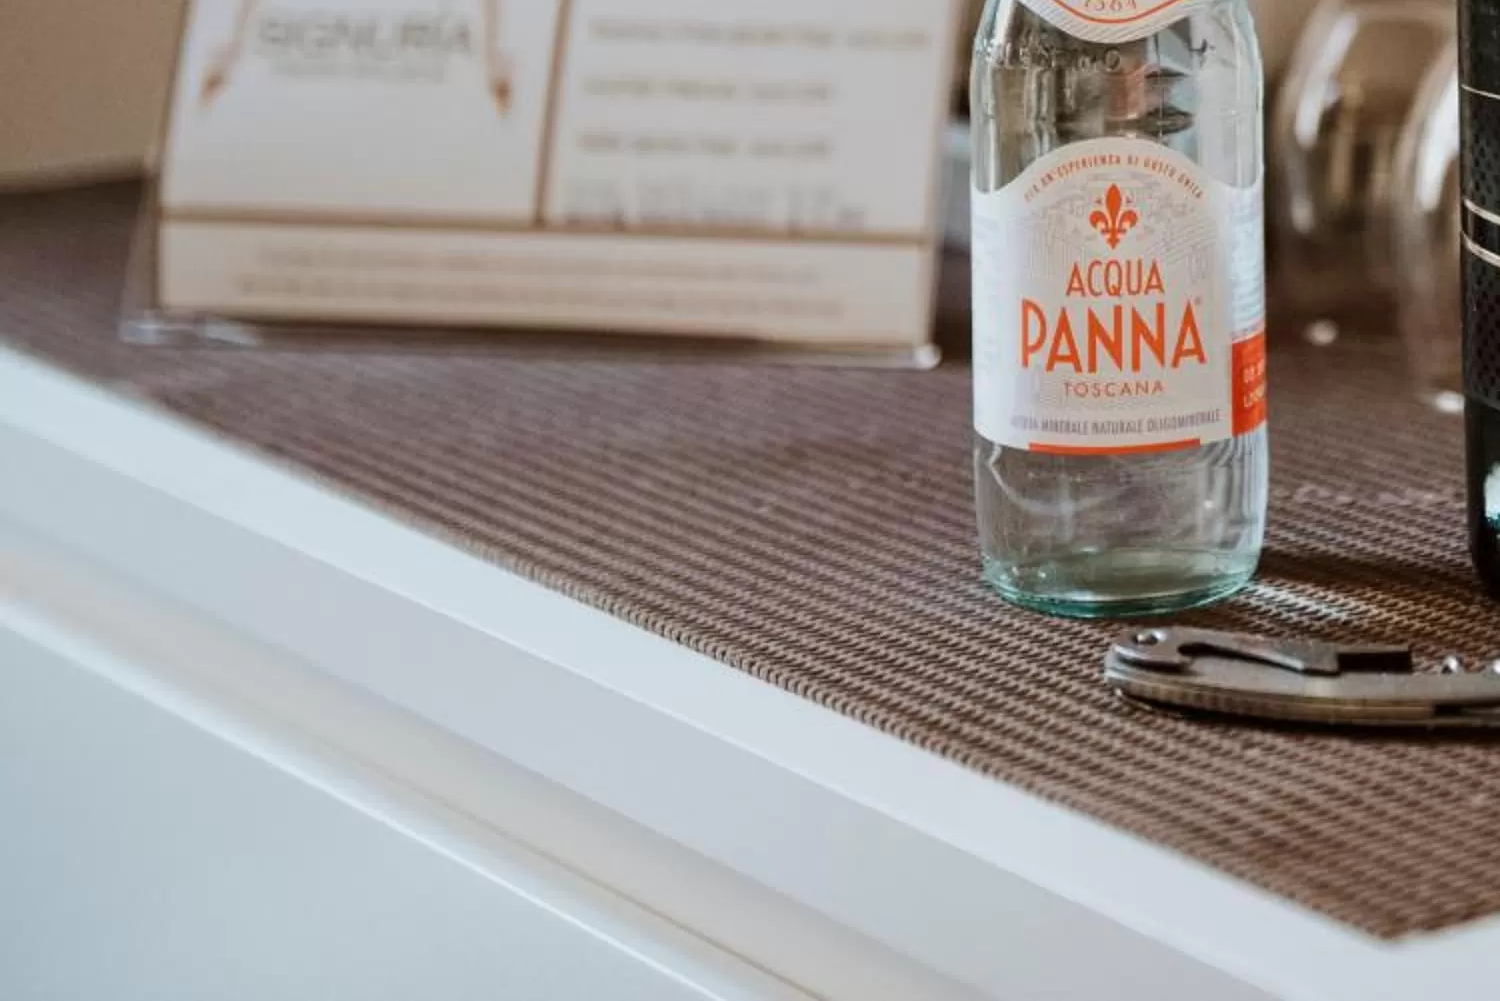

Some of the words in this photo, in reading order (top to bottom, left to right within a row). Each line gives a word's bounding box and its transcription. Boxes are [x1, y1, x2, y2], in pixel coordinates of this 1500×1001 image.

[1065, 258, 1166, 298] ACQUA
[1021, 297, 1207, 374] PANNA
[1063, 379, 1164, 399] TOSCANA
